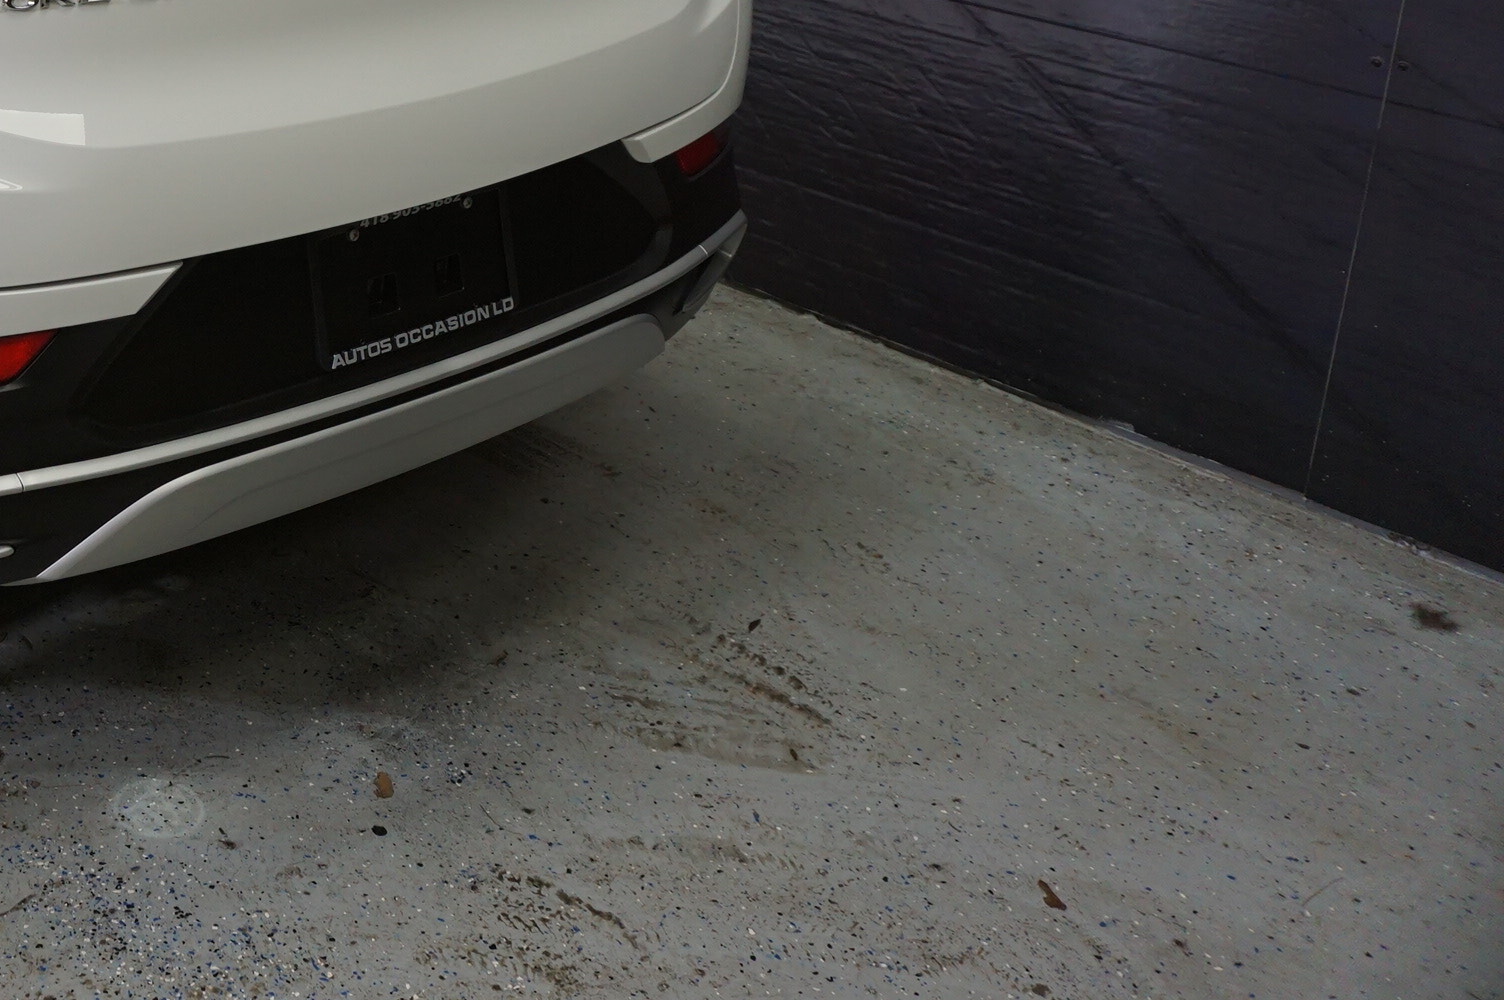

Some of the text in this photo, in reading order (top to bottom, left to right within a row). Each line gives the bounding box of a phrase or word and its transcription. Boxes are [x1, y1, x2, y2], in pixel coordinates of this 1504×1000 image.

[331, 296, 515, 370] AUTOS OCCASION LD
